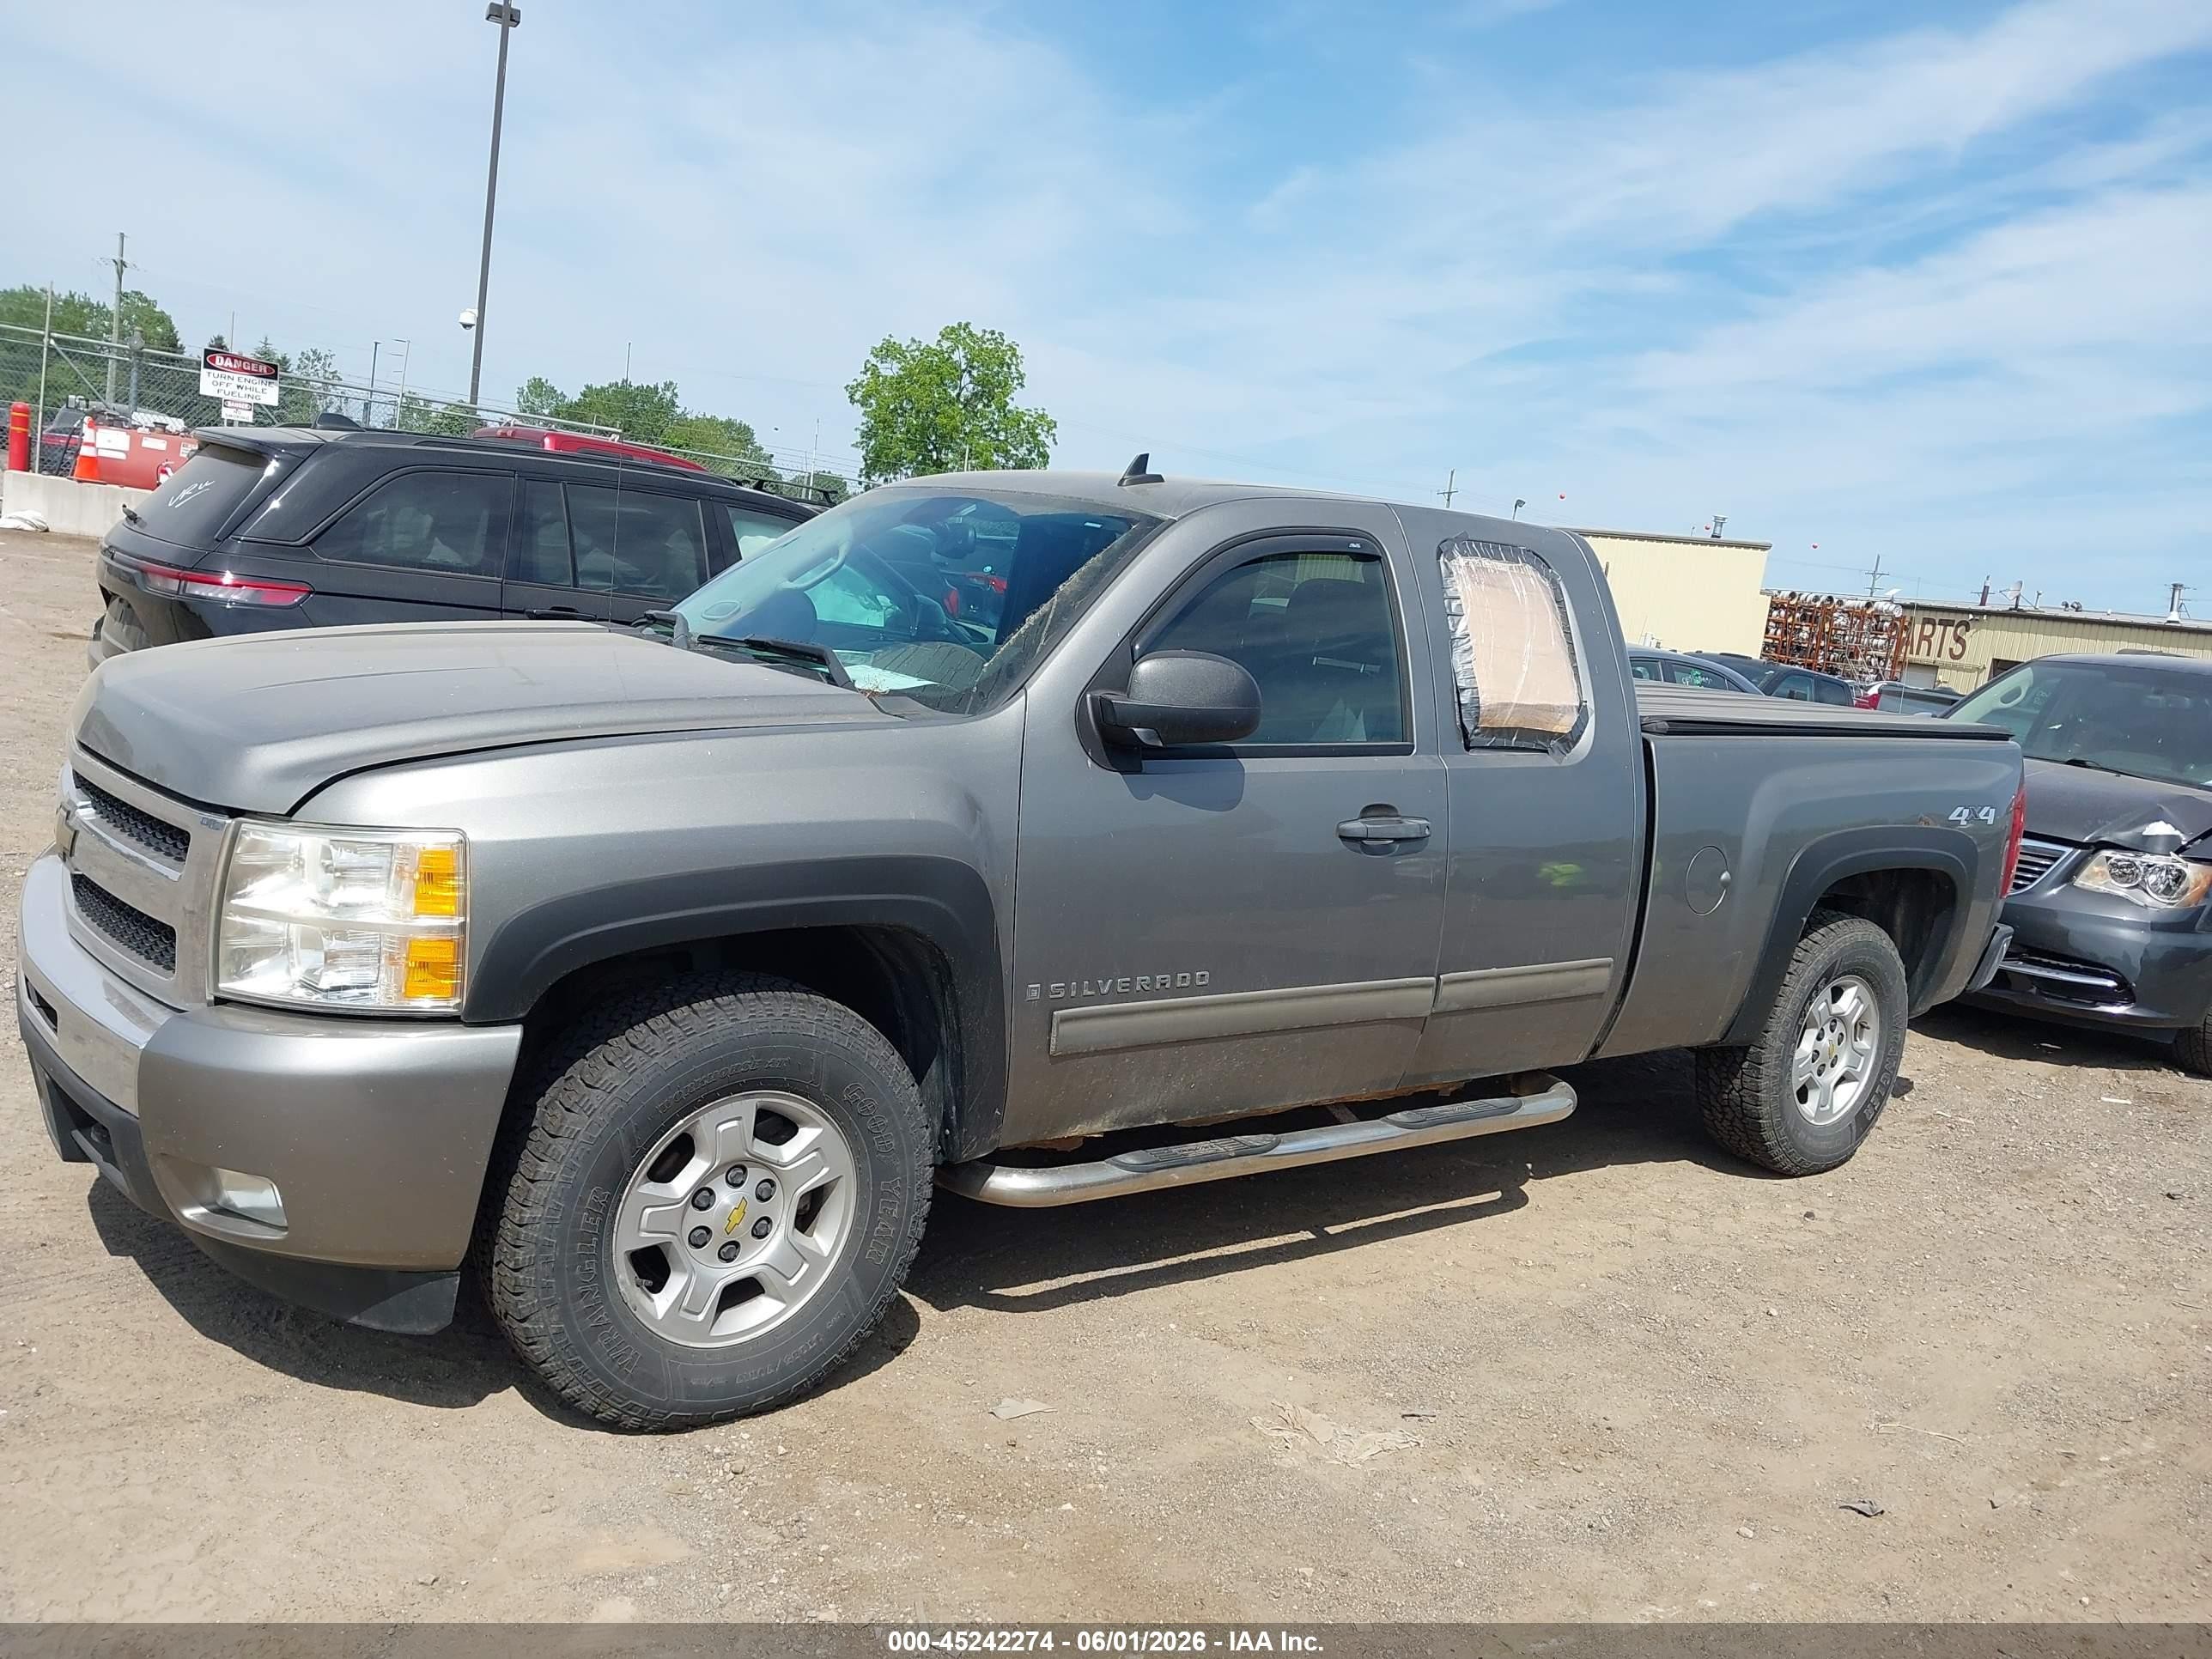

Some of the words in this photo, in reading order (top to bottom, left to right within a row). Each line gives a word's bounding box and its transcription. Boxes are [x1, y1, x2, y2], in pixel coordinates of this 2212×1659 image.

[215, 355, 267, 374] DANGER
[206, 371, 234, 380] TURN
[237, 376, 275, 388] ENGINE
[211, 380, 233, 388] OFF
[236, 384, 268, 394] WHILE
[216, 389, 262, 401] FUELING
[1048, 970, 1210, 999] SILVERADO
[576, 1186, 642, 1374] WRANGLER
